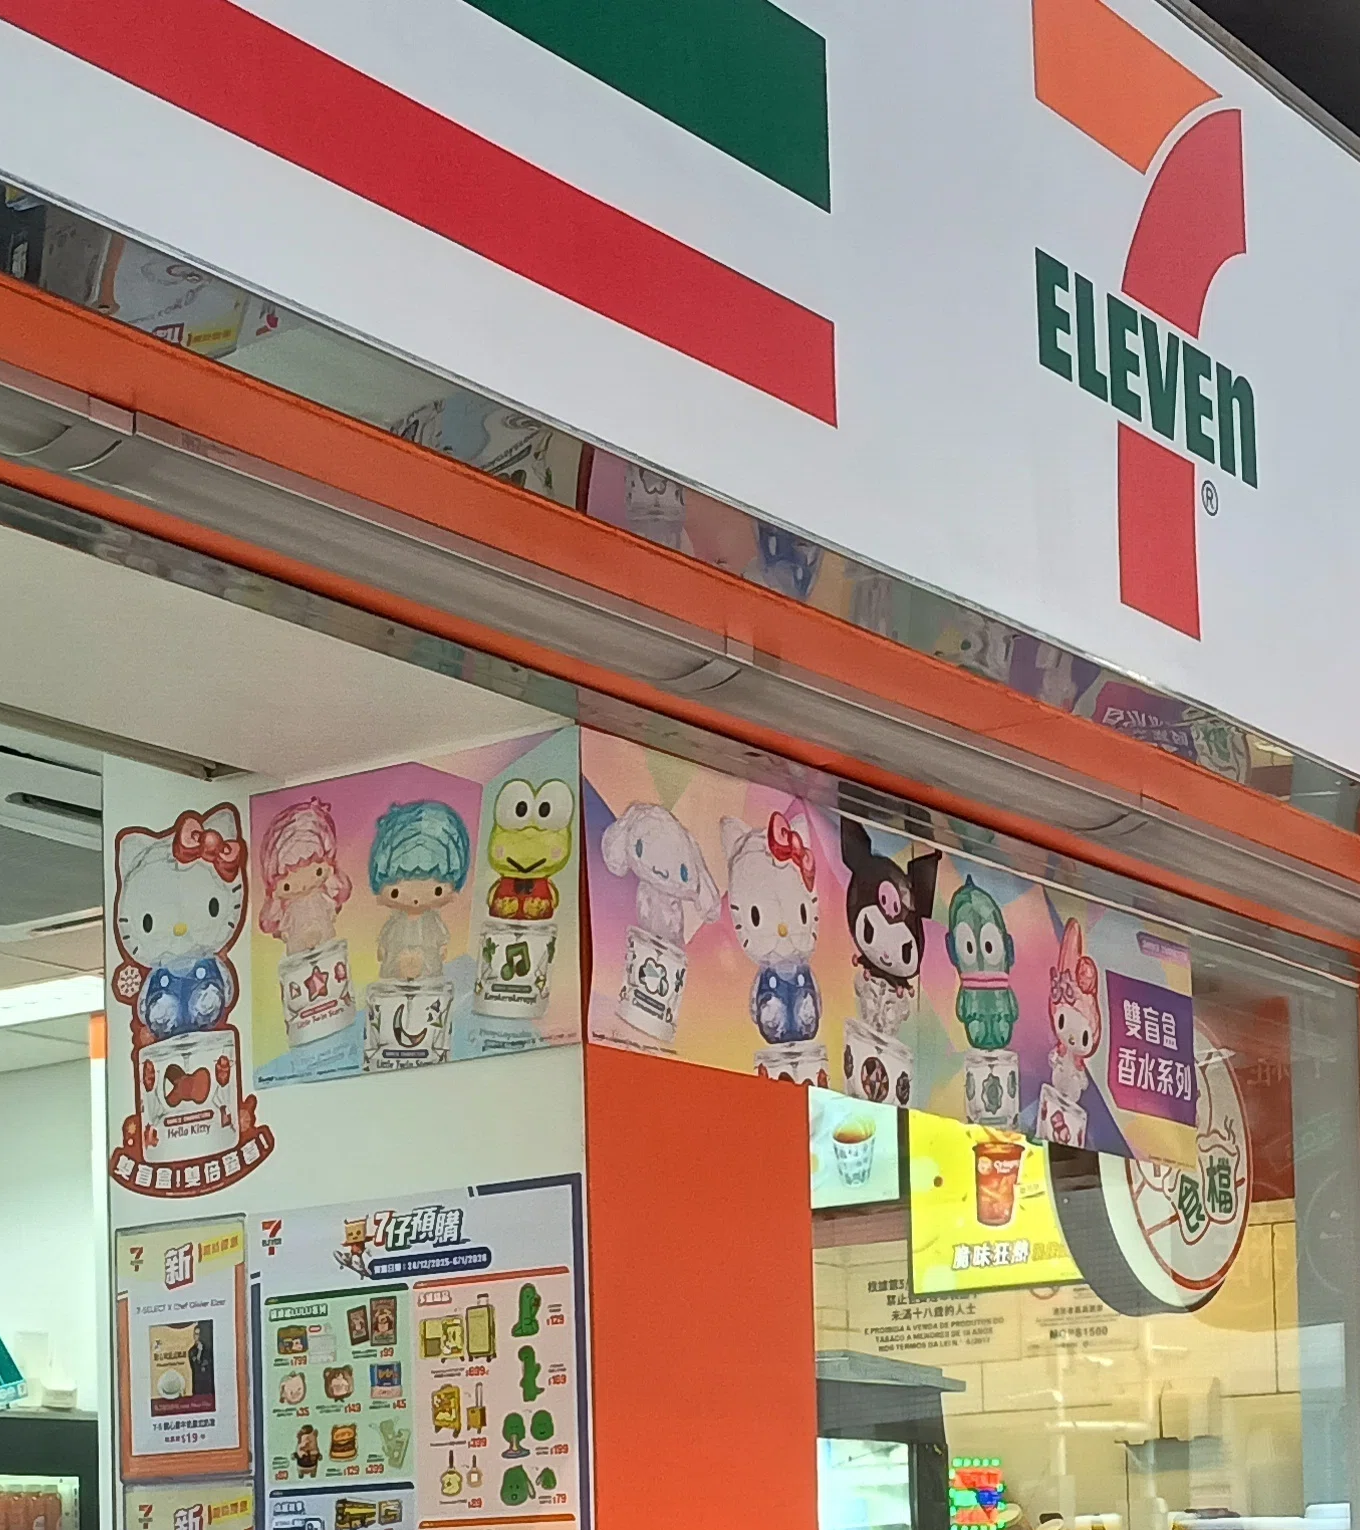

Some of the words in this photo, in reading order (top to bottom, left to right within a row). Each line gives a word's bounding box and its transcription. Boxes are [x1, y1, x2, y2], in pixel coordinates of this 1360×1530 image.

[1033, 0, 1247, 641] 7
[1123, 998, 1180, 1052] 雙盲盒
[1117, 1048, 1194, 1103] 香水系列
[374, 1205, 463, 1250] 7仔預購
[165, 1242, 193, 1286] 新
